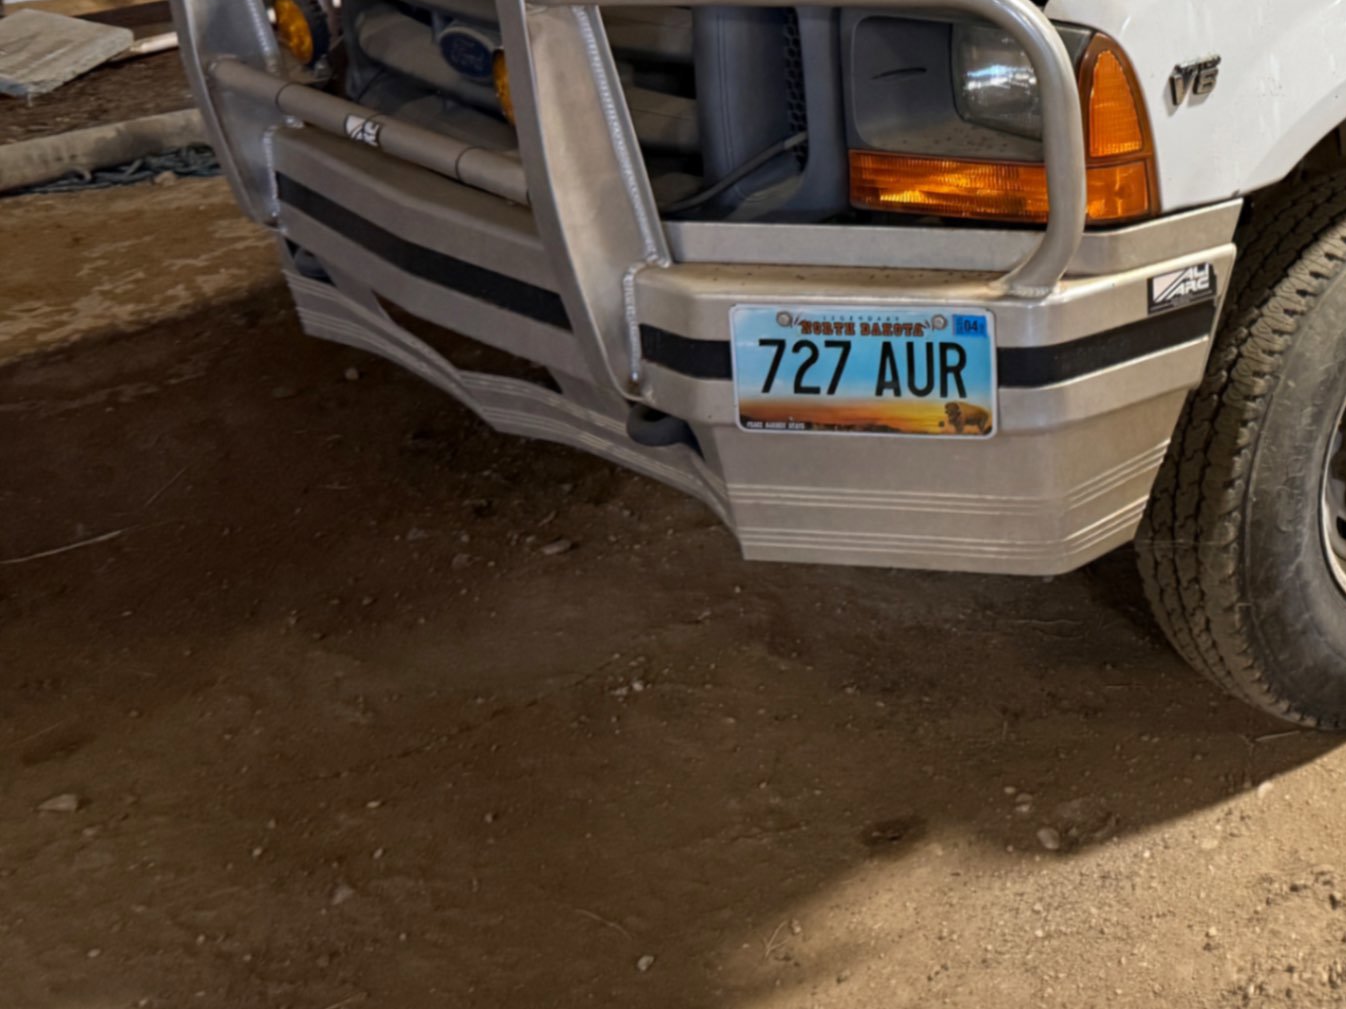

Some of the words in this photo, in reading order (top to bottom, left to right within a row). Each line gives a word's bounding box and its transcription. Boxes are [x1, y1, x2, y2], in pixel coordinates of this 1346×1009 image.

[800, 320, 856, 336] NORTH
[860, 322, 925, 337] DAKOTA
[964, 319, 978, 333] 04
[758, 338, 852, 395] 727
[874, 341, 967, 399] AUR
